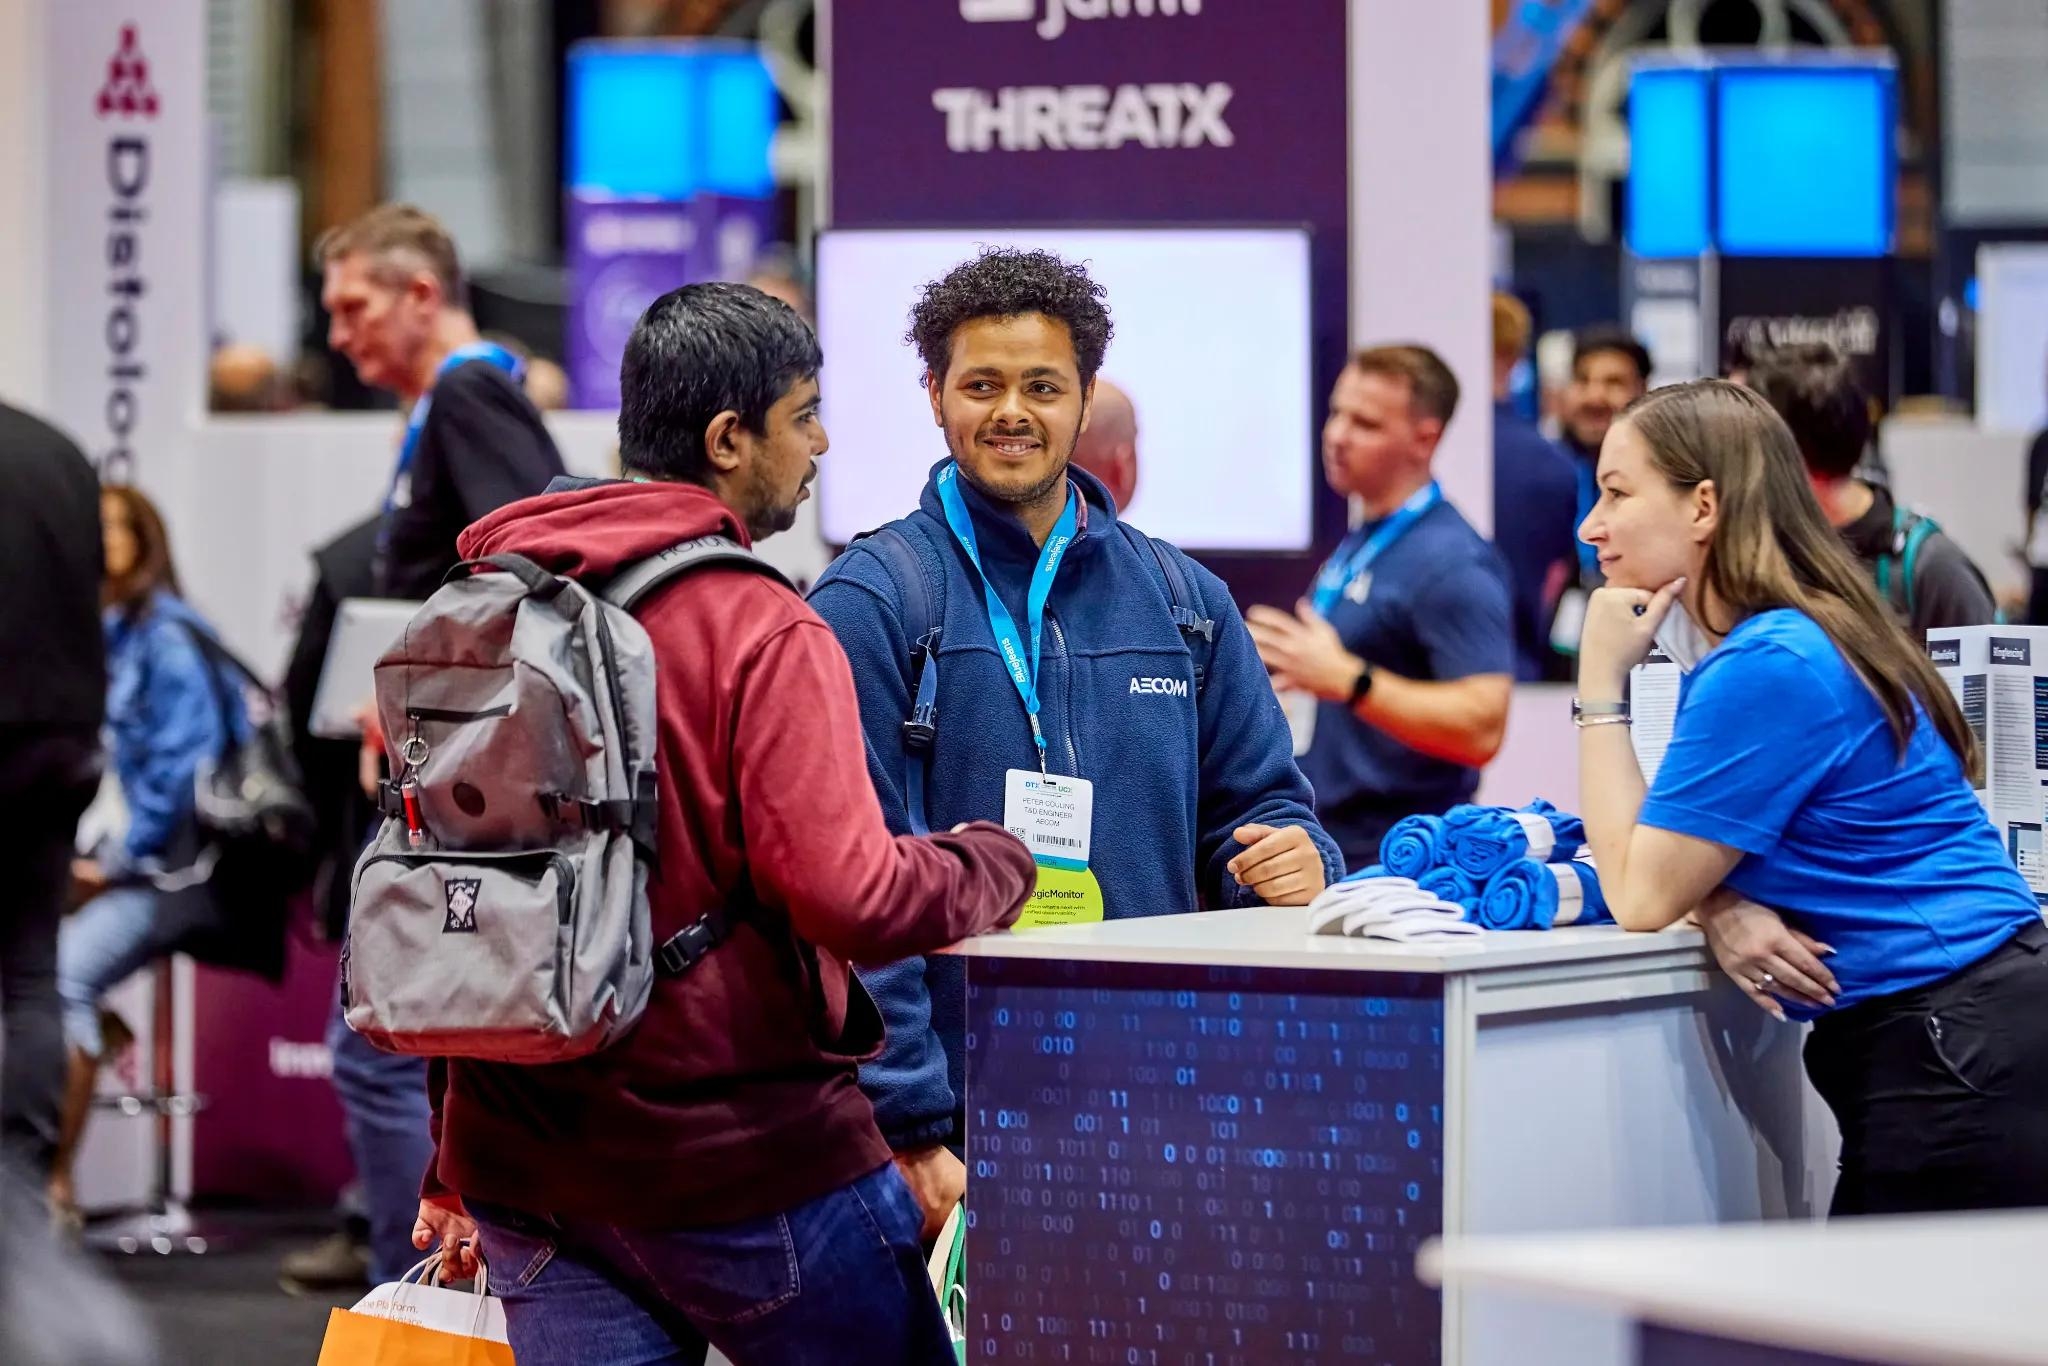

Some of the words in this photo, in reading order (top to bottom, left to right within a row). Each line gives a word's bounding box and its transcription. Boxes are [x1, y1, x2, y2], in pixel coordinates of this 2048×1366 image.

[932, 82, 1234, 152] THREATX
[1001, 637, 1025, 683] BlueJeans
[1129, 677, 1188, 698] AECOM
[1031, 889, 1085, 900] ogicMonitor
